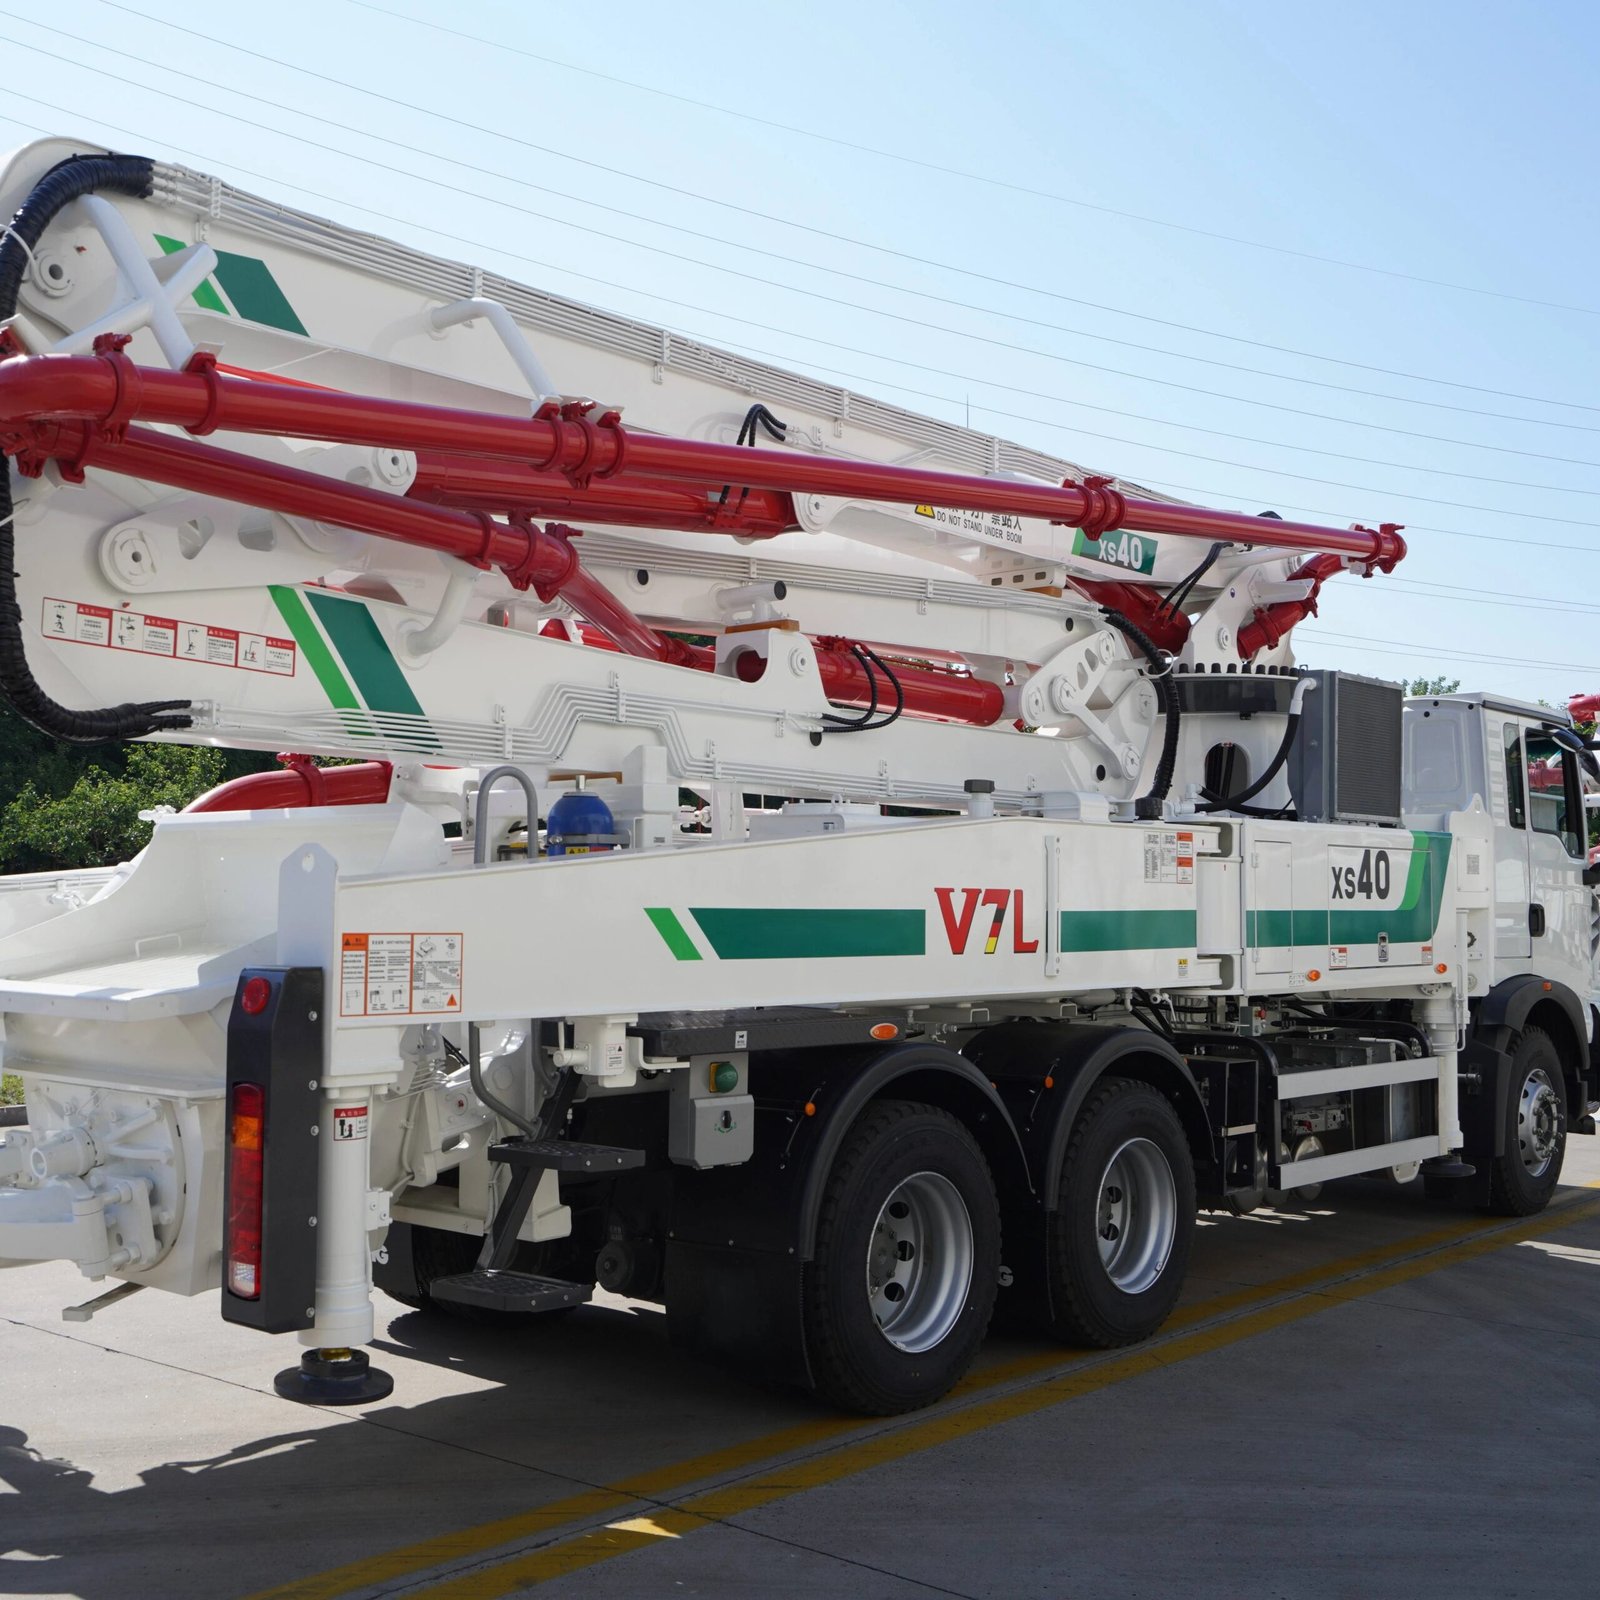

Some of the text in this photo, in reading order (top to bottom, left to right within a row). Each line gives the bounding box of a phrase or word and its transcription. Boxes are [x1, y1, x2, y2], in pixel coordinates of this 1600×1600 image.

[936, 510, 947, 523] DO
[948, 514, 961, 527] NOT
[963, 518, 983, 533] STAND
[984, 525, 1004, 540] UNDER
[1006, 530, 1023, 545] BOOM
[934, 887, 1040, 955] V7L
